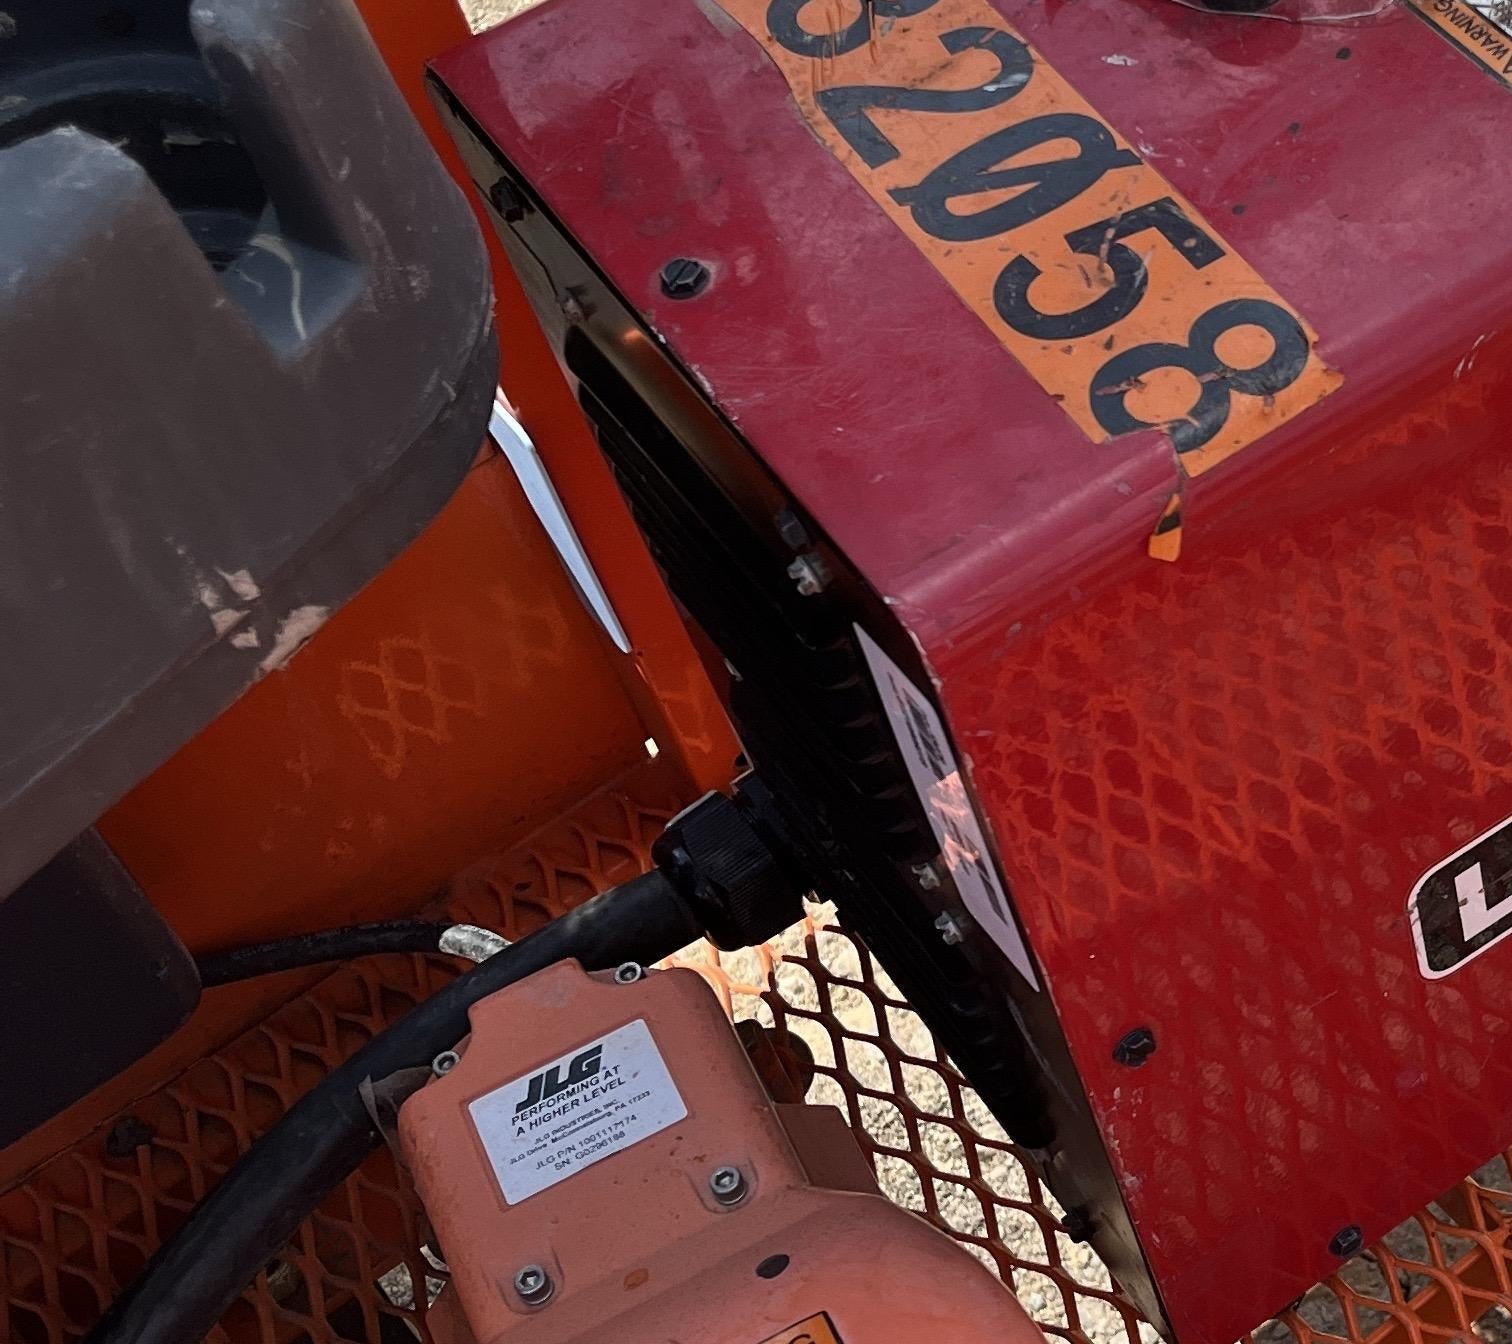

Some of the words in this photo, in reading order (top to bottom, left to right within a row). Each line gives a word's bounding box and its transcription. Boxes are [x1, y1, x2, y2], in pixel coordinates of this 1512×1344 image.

[512, 1076, 599, 1126] PERFORMING
[604, 1065, 620, 1080] AT
[513, 1125, 526, 1137] A
[530, 1099, 580, 1130] HIGHER
[584, 1078, 625, 1102] LEVEL
[515, 1044, 603, 1114] JLG
[536, 1155, 555, 1169] JLG
[557, 1145, 576, 1158] P/N
